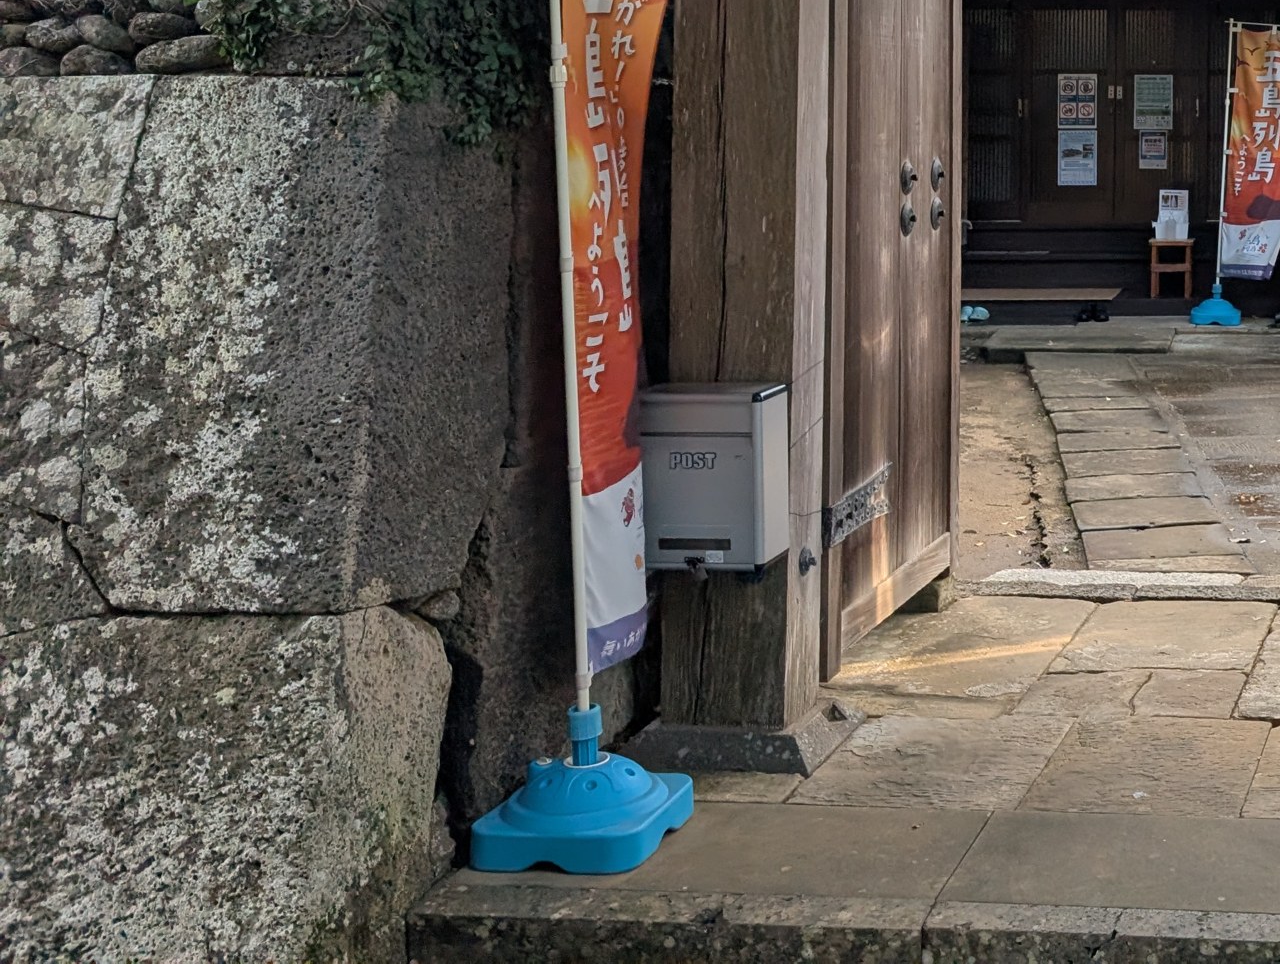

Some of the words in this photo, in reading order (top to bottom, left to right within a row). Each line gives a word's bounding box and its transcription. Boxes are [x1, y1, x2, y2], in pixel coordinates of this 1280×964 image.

[1234, 133, 1251, 197] へようこそ
[582, 189, 609, 394] へようこそ
[669, 451, 717, 470] POST
